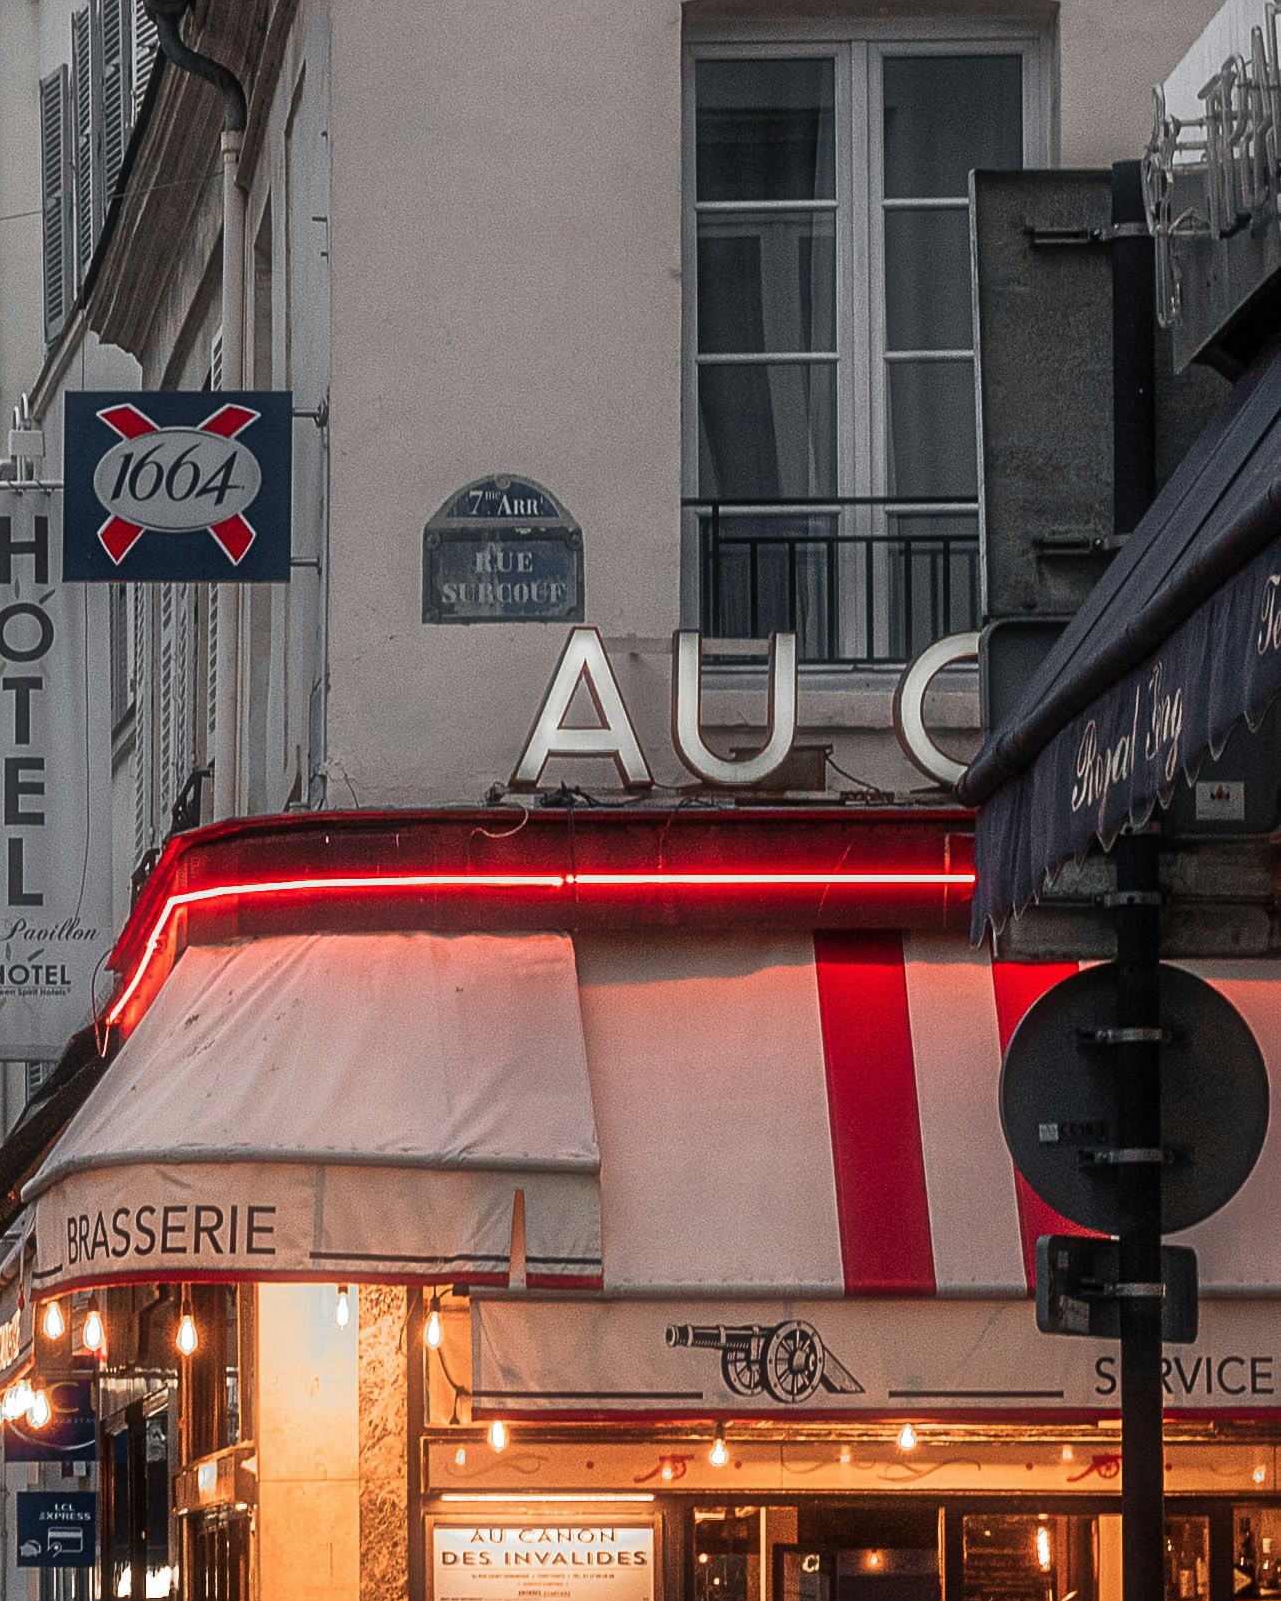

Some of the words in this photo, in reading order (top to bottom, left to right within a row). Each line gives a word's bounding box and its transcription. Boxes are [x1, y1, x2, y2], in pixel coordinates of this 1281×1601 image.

[112, 445, 244, 505] 1664
[475, 551, 533, 573] RUE
[441, 582, 567, 604] SURCOUF
[510, 627, 797, 789] AU
[1072, 685, 1140, 835] Royal
[18, 988, 38, 997] Spirit
[66, 1205, 277, 1265] BRASSERIE
[1095, 1356, 1275, 1396] SRVICE
[54, 1503, 74, 1511] LCL
[470, 1529, 504, 1543] AU
[518, 1528, 616, 1544] CANON
[441, 1551, 492, 1566] DES
[504, 1551, 648, 1566] INVALIDES
